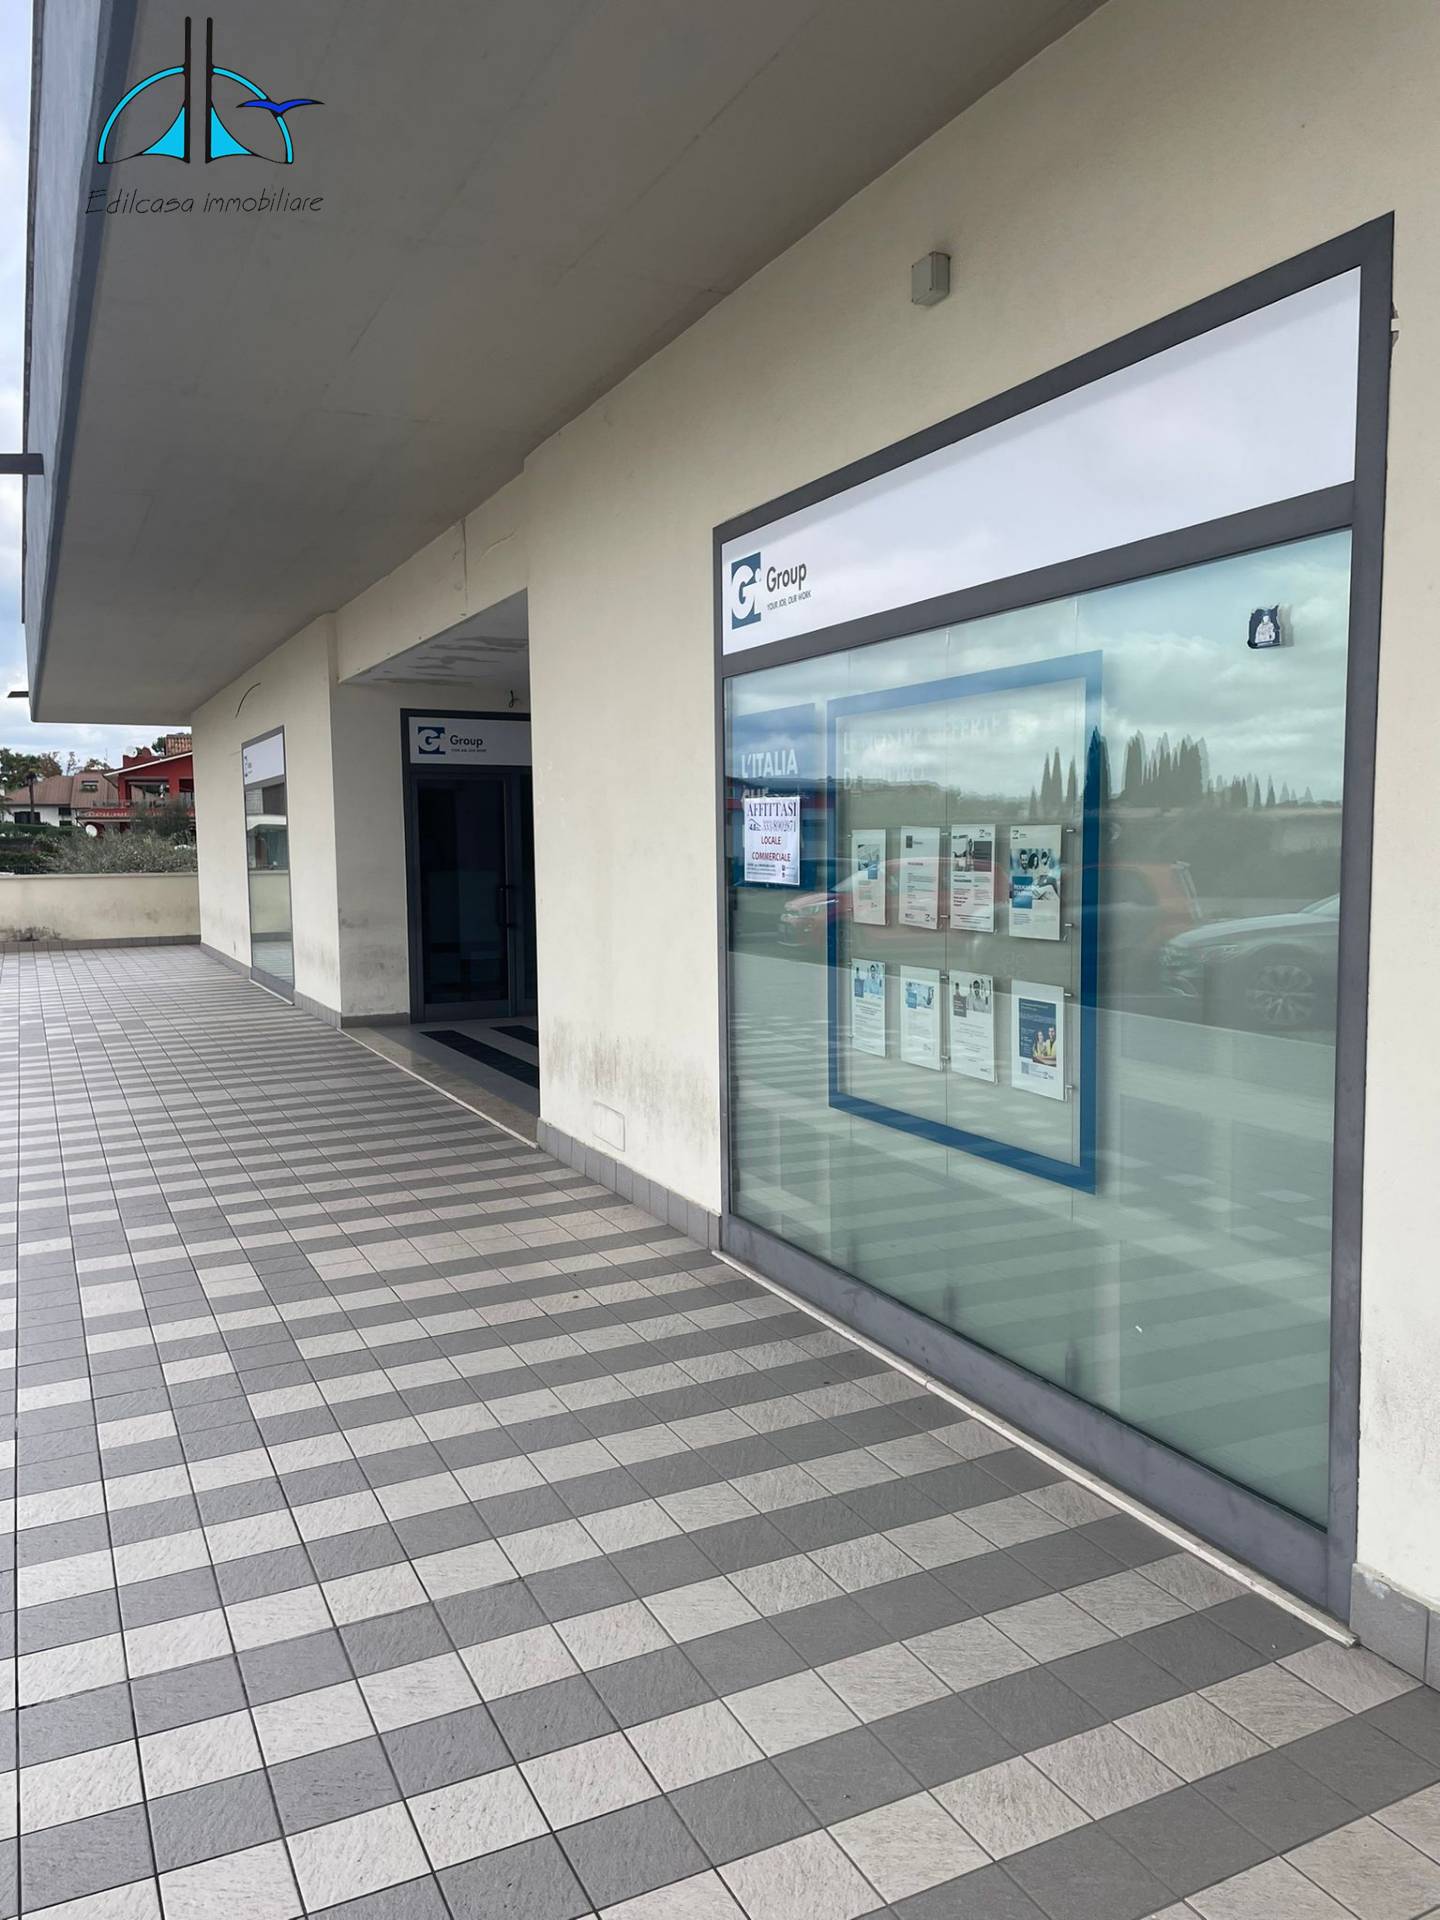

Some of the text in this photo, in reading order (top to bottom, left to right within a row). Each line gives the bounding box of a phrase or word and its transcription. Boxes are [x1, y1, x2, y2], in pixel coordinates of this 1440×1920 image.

[766, 563, 807, 592] Group
[449, 734, 484, 749] Group
[741, 748, 799, 779] L'ITALIA
[747, 802, 797, 817] AFFITTASI
[760, 835, 783, 846] LOCALE
[751, 851, 792, 863] COMMERCIALE
